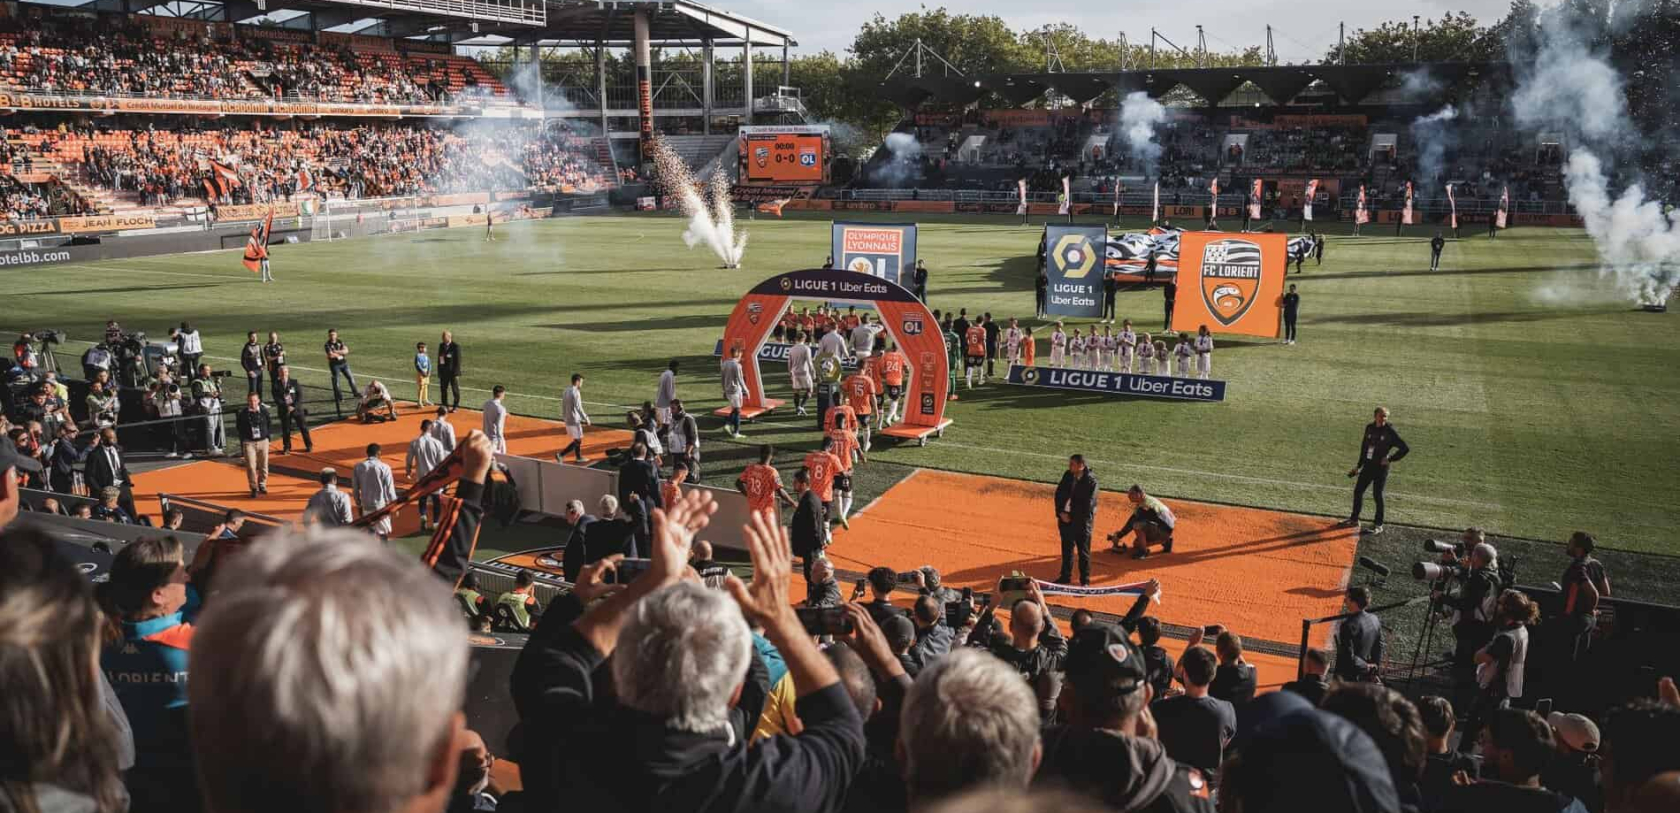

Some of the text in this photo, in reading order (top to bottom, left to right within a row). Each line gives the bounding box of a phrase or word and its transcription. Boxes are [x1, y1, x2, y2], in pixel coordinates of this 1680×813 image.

[34, 94, 80, 108] HOTELS
[151, 101, 177, 110] Mutuel
[178, 102, 187, 111] de
[330, 106, 354, 115] umbro
[367, 107, 389, 115] umbro
[801, 155, 815, 164] OL
[846, 202, 876, 210] umbro
[19, 222, 56, 234] PIZZA
[83, 219, 112, 229] JEAN
[116, 216, 154, 227] FLOCH
[848, 232, 898, 241] OLYMPIQUE
[847, 241, 898, 251] LYONNAIS
[1203, 264, 1260, 278] FC LORIENT
[794, 280, 888, 294] LIGUE 1 Uber Eats
[1054, 284, 1093, 294] LIGUE 1
[1051, 295, 1095, 306] Uber Eats
[904, 322, 921, 333] OL
[760, 345, 791, 358] GUE
[886, 360, 899, 372] 24
[1050, 370, 1213, 397] LIGUE 1 Uber Eats
[854, 384, 864, 397] 15
[834, 440, 844, 454] 11
[814, 464, 824, 480] 8
